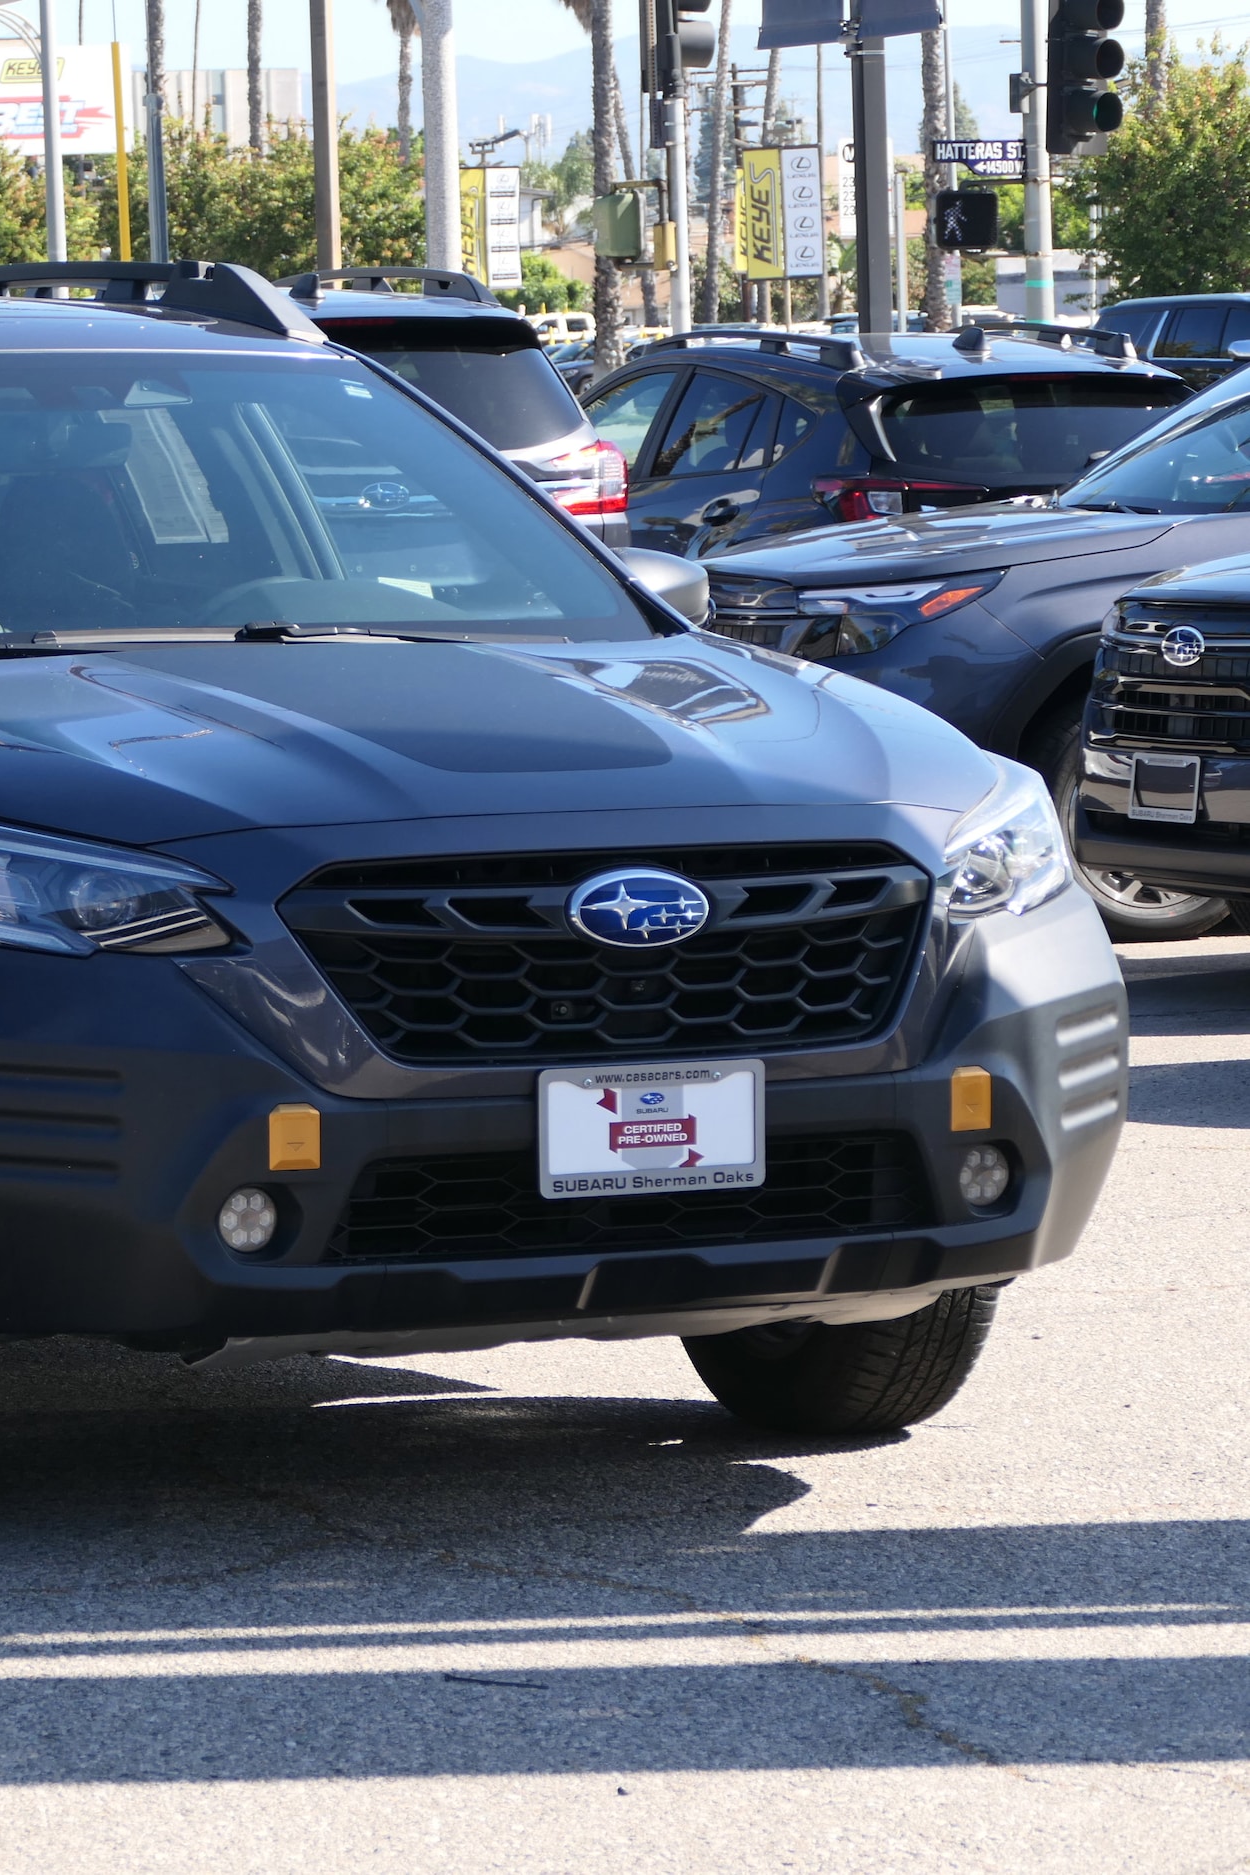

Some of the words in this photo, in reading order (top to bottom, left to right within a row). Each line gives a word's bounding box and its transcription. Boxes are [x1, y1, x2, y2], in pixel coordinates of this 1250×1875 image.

[936, 142, 1003, 160] HATTERAS
[1006, 142, 1025, 159] ST.
[986, 160, 1014, 174] 14500
[750, 162, 778, 267] KEYES
[595, 1069, 710, 1084] www.casacars.com
[636, 1107, 669, 1115] SUBARU
[624, 1123, 682, 1135] CERTIFIED
[618, 1133, 688, 1145] PRE-OWNED
[553, 1177, 627, 1193] SUBARU
[633, 1174, 707, 1189] Sherman
[713, 1171, 754, 1185] Oaks
